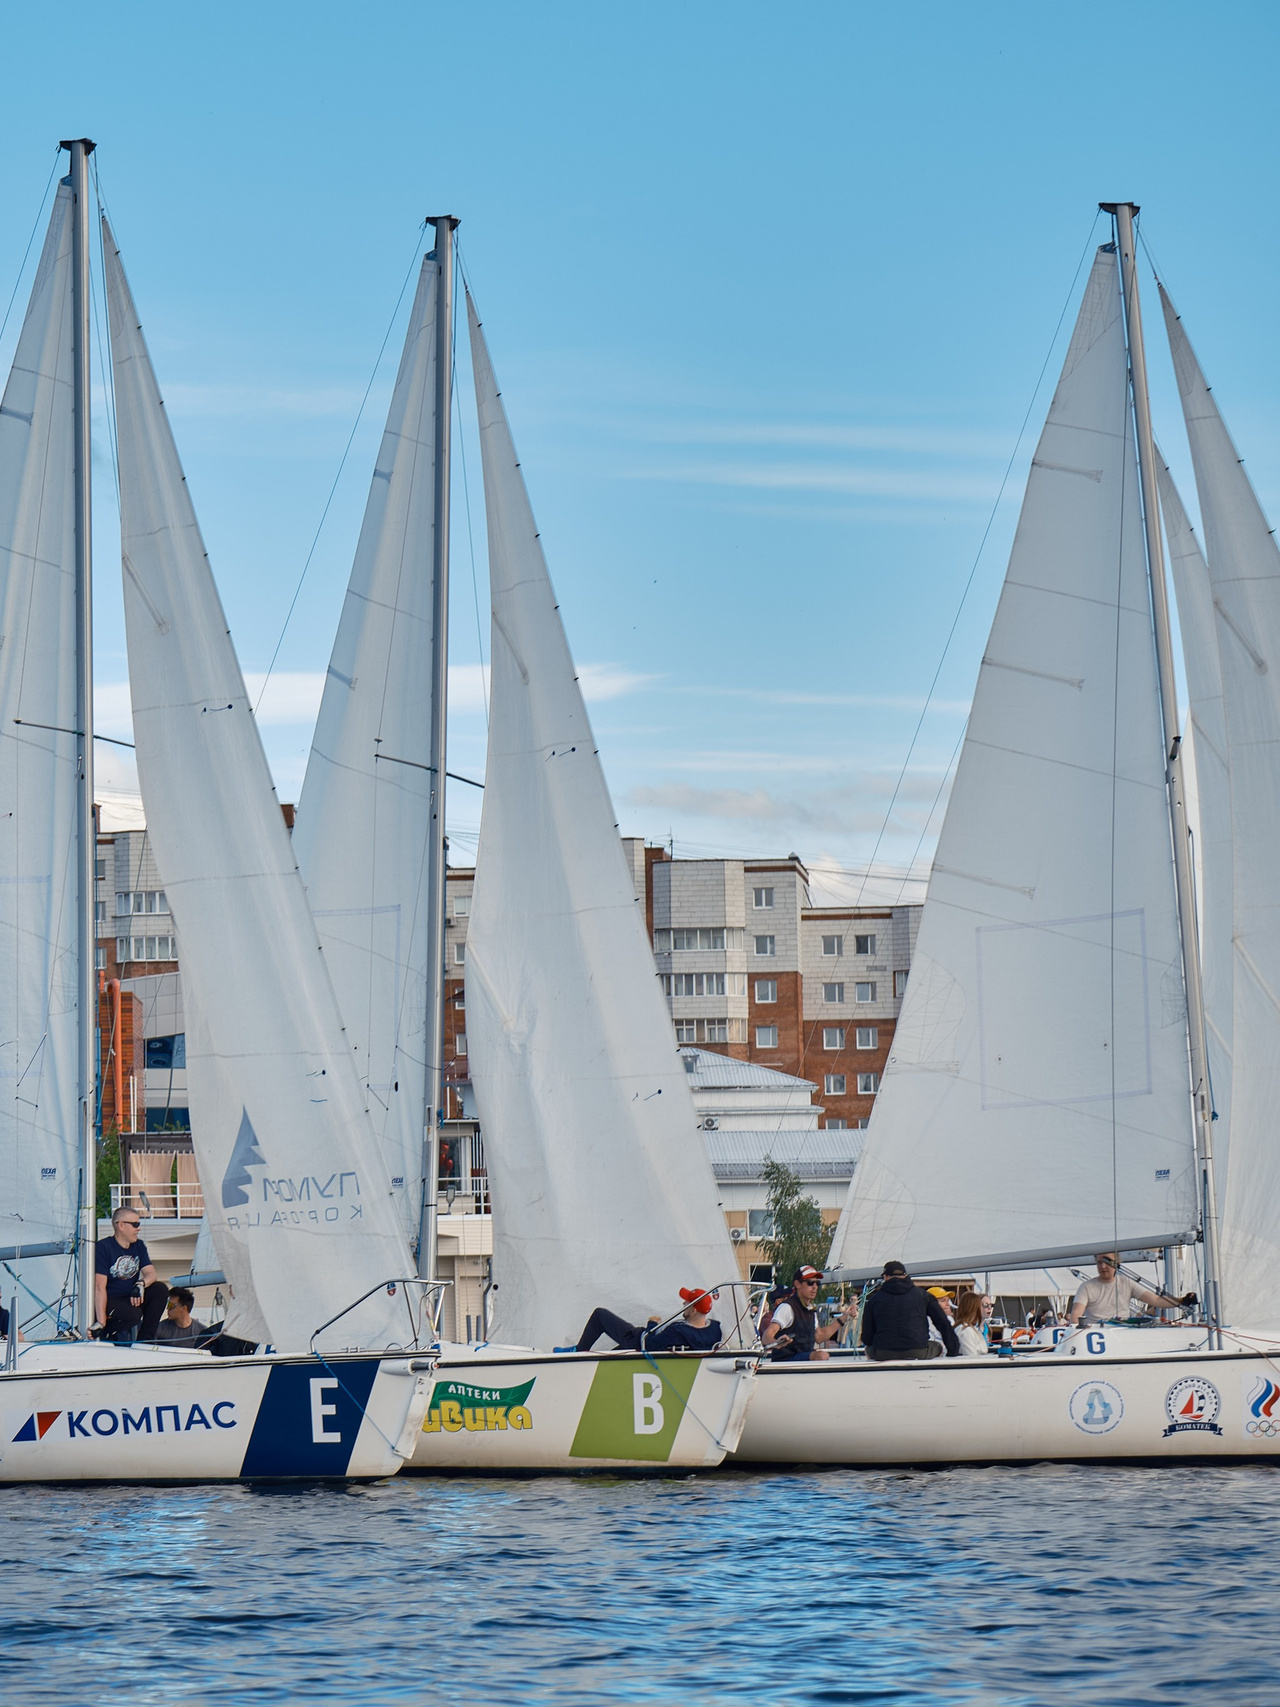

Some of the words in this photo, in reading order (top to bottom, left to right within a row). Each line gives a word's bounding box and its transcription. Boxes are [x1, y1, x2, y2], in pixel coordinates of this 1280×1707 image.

[1086, 1331, 1106, 1355] G
[309, 1377, 342, 1443] E
[448, 1383, 501, 1401] АПТЕКИ
[632, 1372, 665, 1435] B
[67, 1400, 238, 1438] КОМПАС
